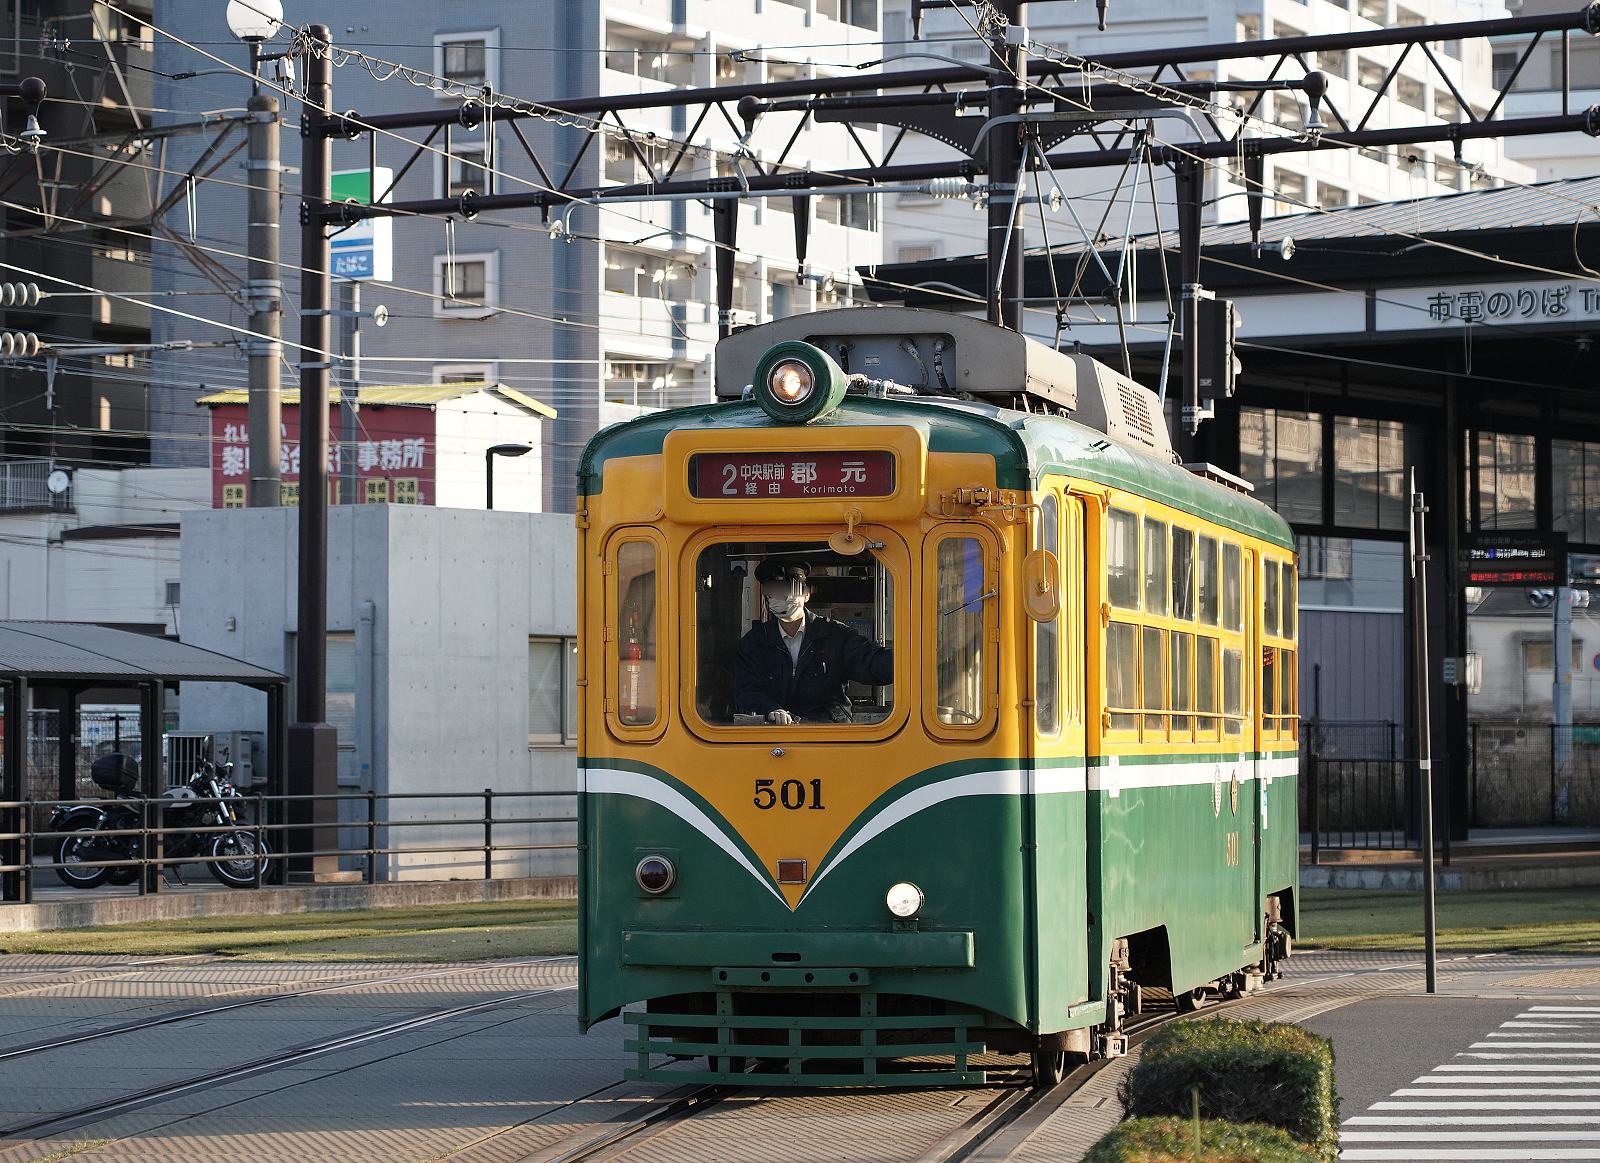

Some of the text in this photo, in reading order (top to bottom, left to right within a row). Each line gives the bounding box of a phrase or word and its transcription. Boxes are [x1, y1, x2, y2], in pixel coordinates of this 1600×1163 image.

[335, 255, 368, 273] たばこ
[1427, 285, 1569, 321] 市電のりば
[722, 464, 738, 495] 2
[740, 463, 785, 481] 中央駅前
[803, 485, 856, 494] Korimoto
[753, 778, 826, 810] 501
[1226, 831, 1239, 867] 501
